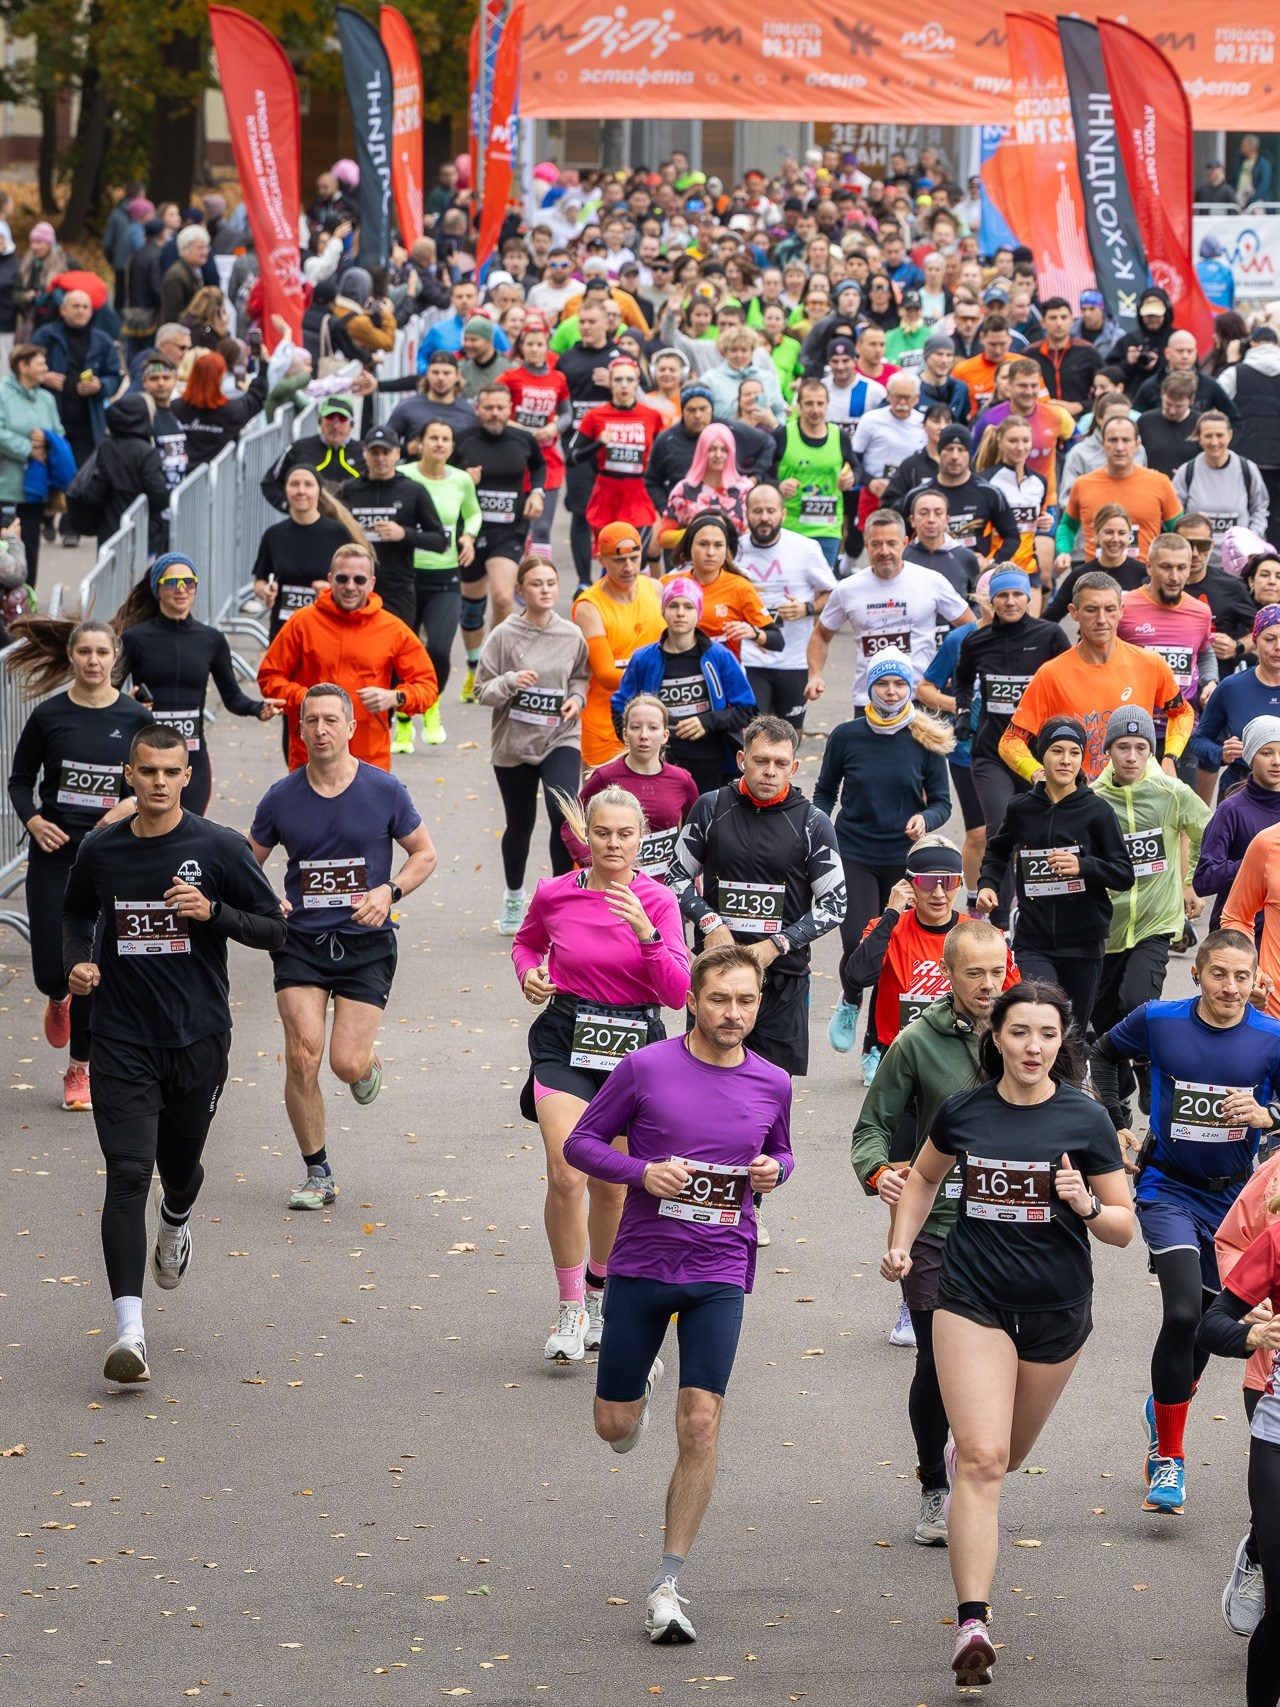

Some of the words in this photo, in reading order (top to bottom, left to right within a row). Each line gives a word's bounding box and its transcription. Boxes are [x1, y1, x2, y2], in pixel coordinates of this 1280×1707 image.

[578, 66, 695, 88] эстафета
[805, 73, 868, 89] осень
[1167, 653, 1188, 669] 86
[519, 693, 557, 711] 2011
[660, 685, 703, 703] 2050
[66, 771, 116, 791] 2072
[309, 870, 358, 892] 25-1
[725, 892, 776, 915] 2139
[126, 914, 178, 936] 31-1
[581, 1027, 640, 1053] 2073
[1179, 1095, 1226, 1118] 200
[976, 1170, 1039, 1198] 16-1
